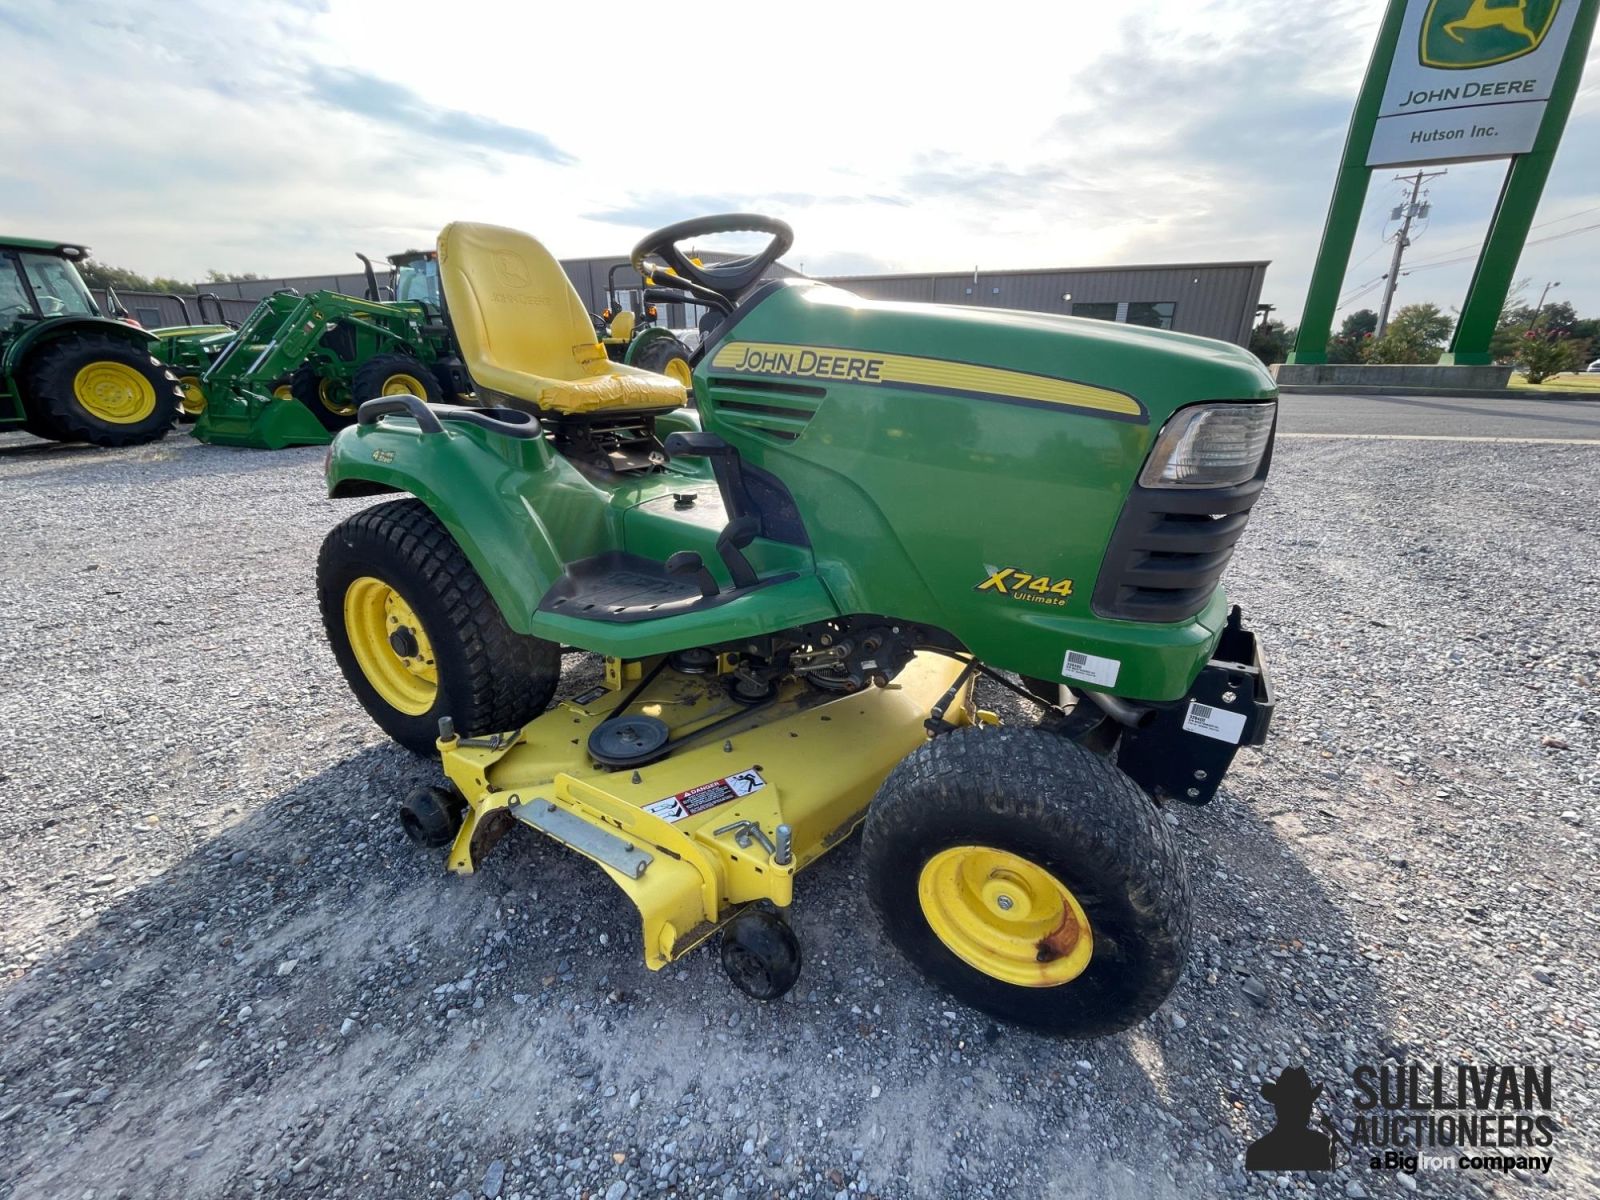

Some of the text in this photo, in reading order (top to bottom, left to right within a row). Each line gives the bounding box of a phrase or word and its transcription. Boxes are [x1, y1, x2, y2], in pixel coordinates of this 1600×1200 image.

[1399, 79, 1537, 107] JOHN DEERE
[1410, 125, 1499, 144] Hutson Inc.
[735, 347, 885, 381] JOHN DEERE
[976, 566, 1073, 597] X744
[1013, 592, 1067, 607] Ultimate
[690, 781, 721, 795] DANGER
